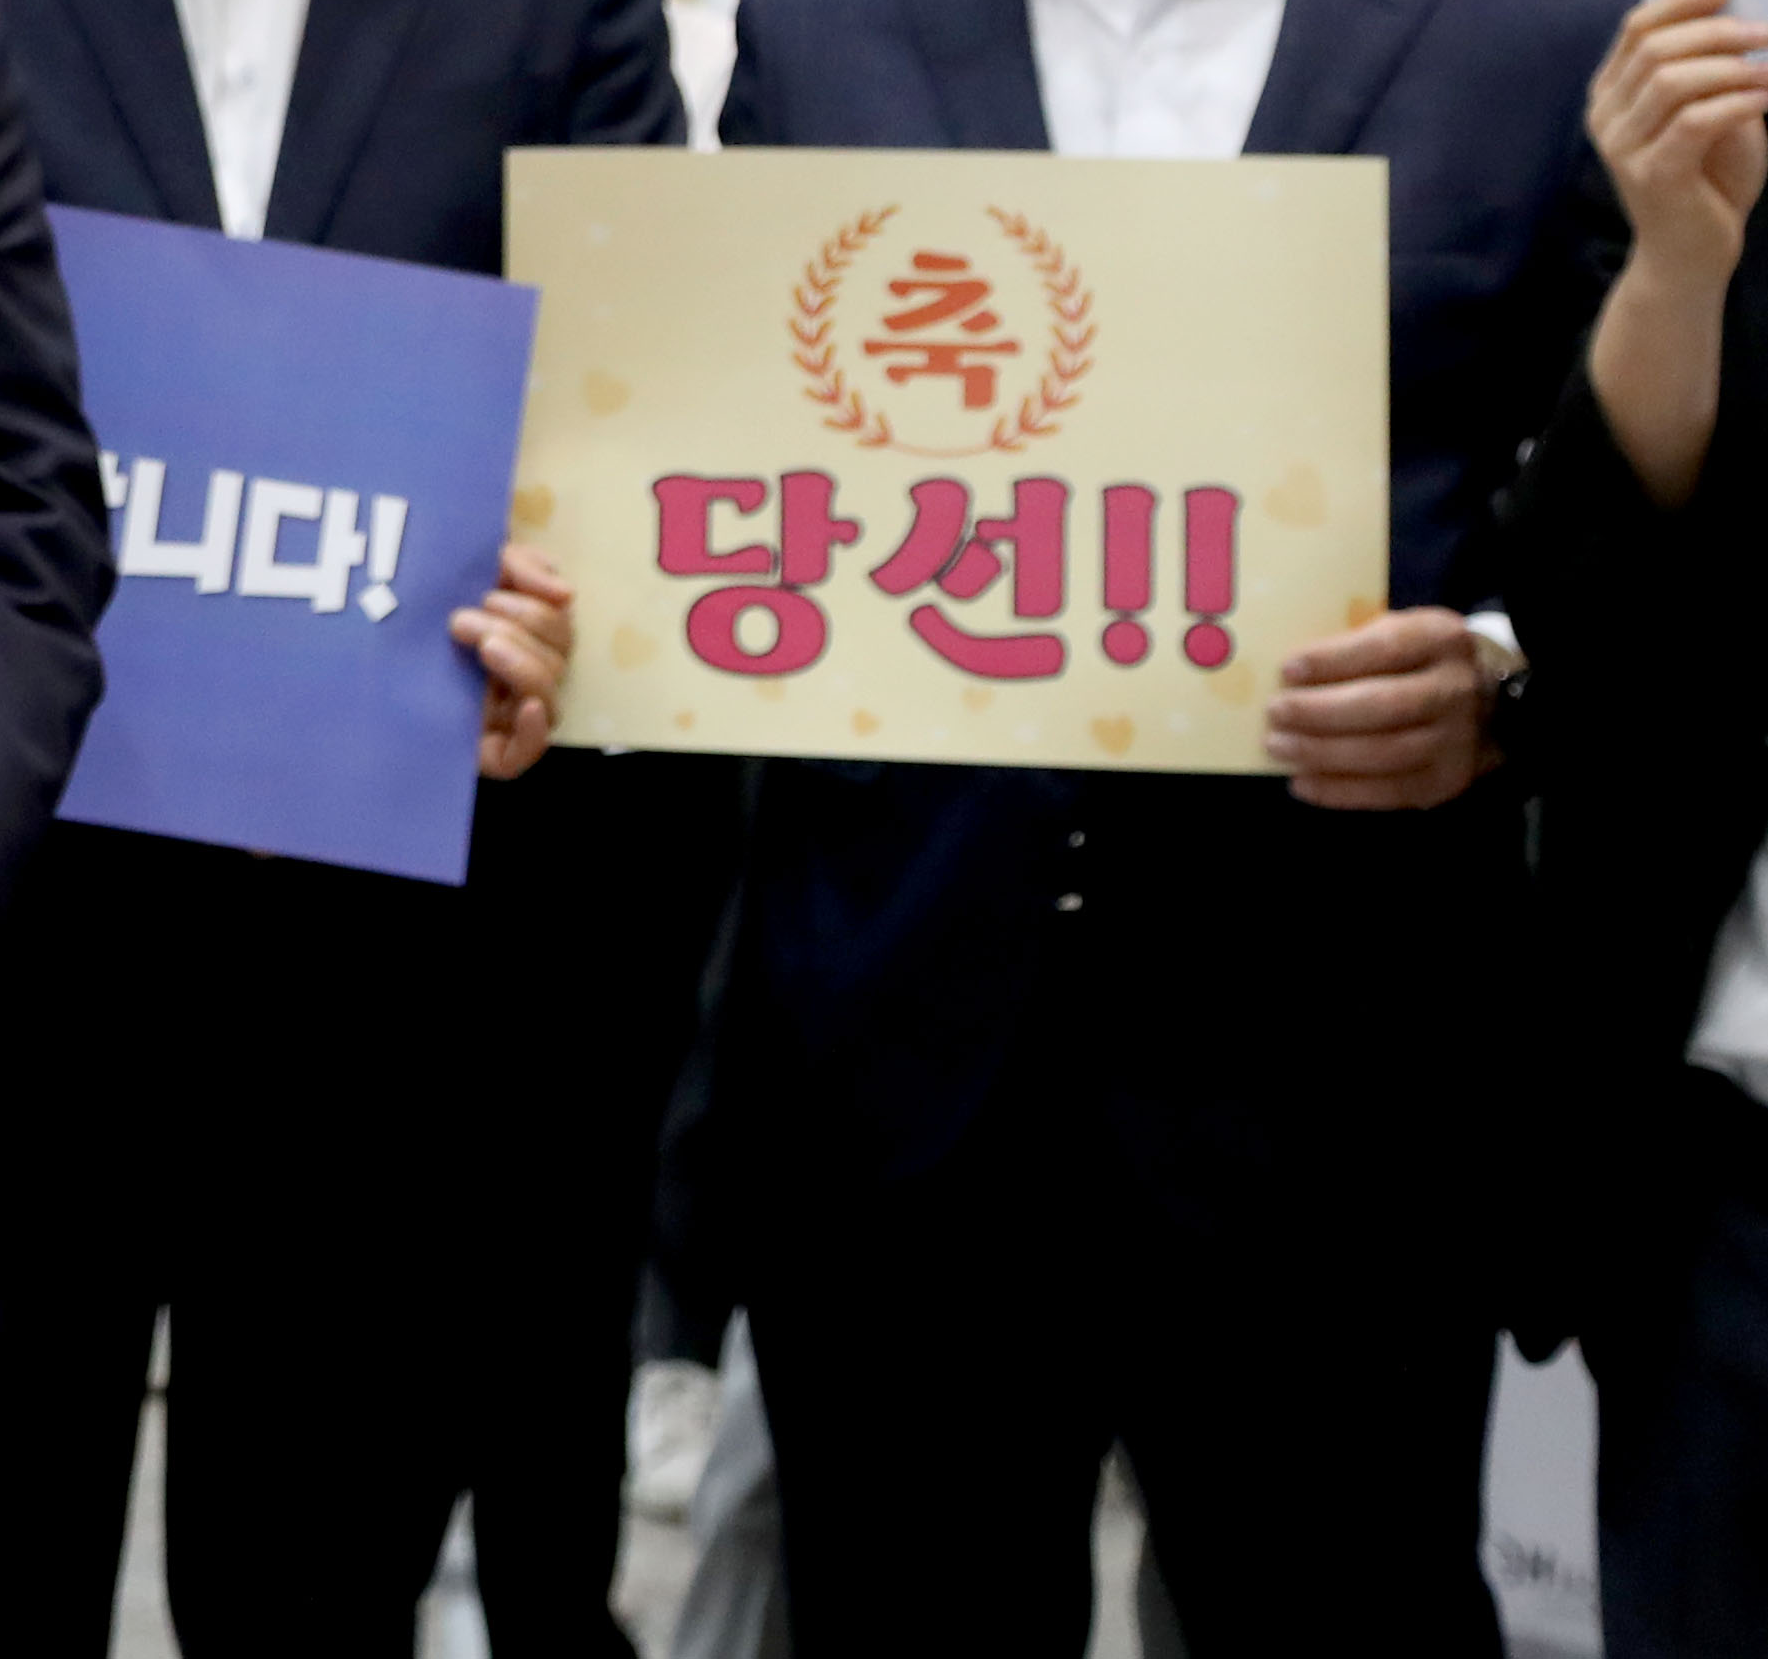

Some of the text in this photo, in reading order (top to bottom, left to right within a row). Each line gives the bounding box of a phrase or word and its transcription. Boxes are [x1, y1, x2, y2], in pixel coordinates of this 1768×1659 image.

[862, 251, 1021, 410] 축
[99, 450, 410, 624] 니다!
[650, 469, 1241, 681] 당선!!
